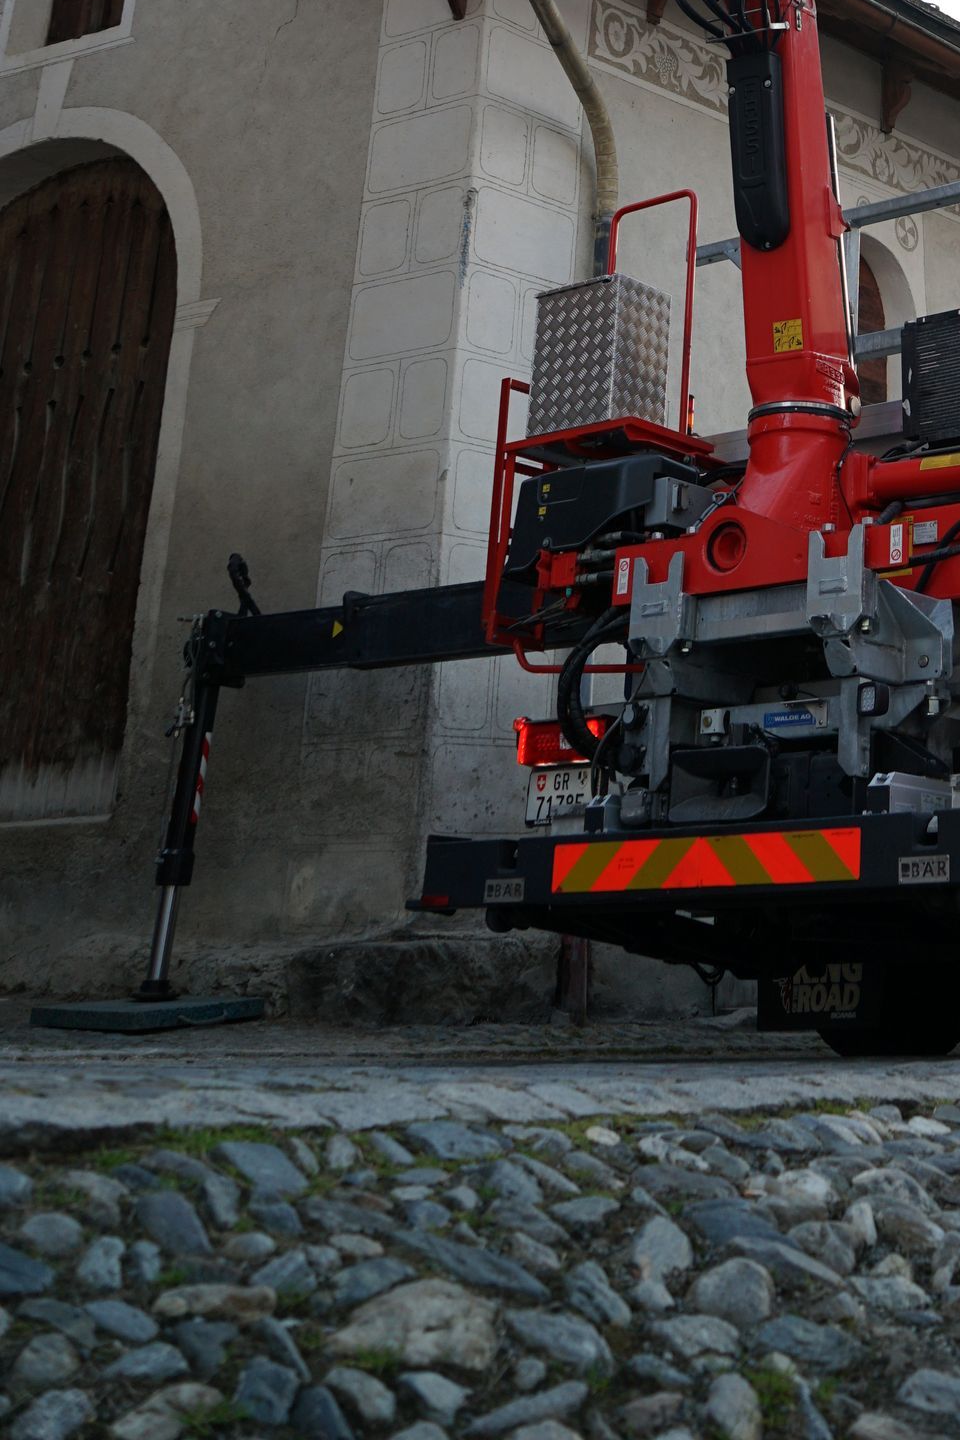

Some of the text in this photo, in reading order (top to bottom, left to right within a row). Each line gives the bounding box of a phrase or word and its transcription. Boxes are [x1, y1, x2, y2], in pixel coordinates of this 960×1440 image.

[744, 80, 760, 174] FASSI
[553, 772, 570, 790] GR
[911, 861, 947, 877] BÄR
[792, 962, 863, 984] KNG
[799, 982, 861, 1013] ROAD
